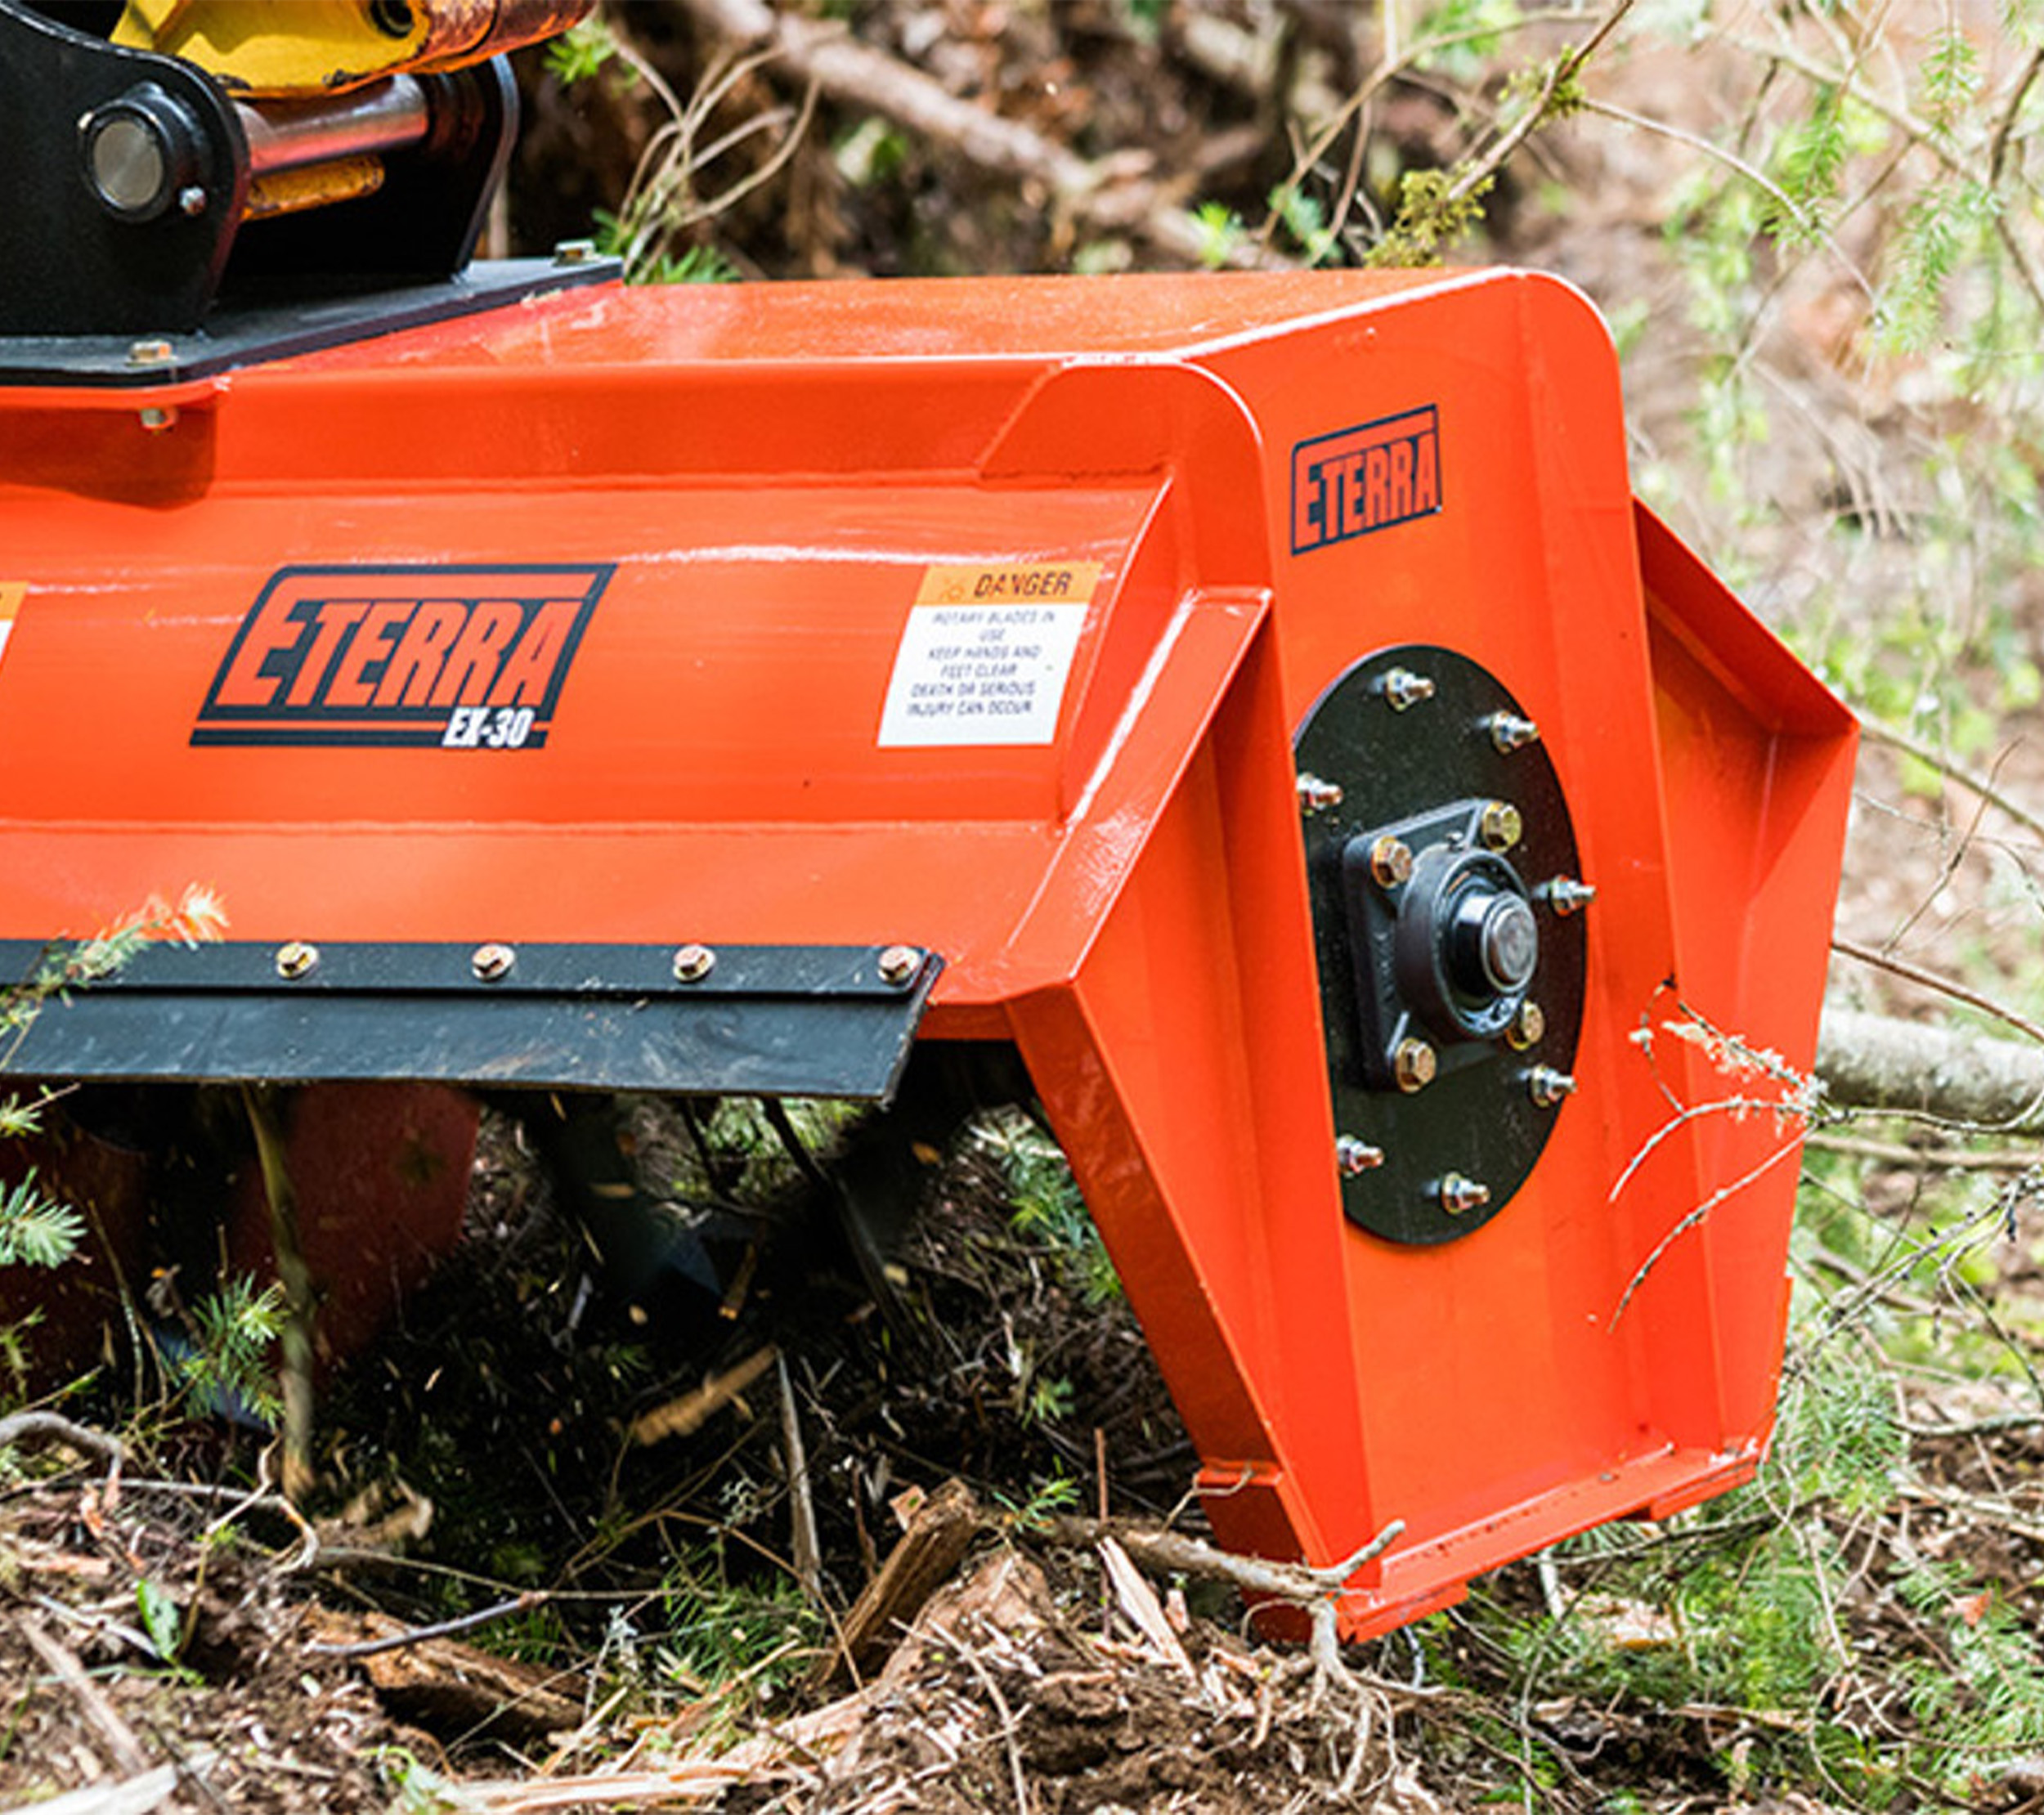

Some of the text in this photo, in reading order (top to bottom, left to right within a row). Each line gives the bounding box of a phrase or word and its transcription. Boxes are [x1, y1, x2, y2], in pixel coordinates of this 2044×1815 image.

[1294, 414, 1438, 549] ETERRA
[974, 571, 1072, 598] DANGER
[214, 575, 594, 706] ETERRA
[1013, 645, 1042, 659] AND
[975, 663, 1017, 677] CLEAR
[909, 680, 1036, 697] DEATH OR SERIOUS
[907, 701, 955, 716] INJURY
[957, 701, 984, 716] CAN
[442, 706, 536, 748] EX-30
